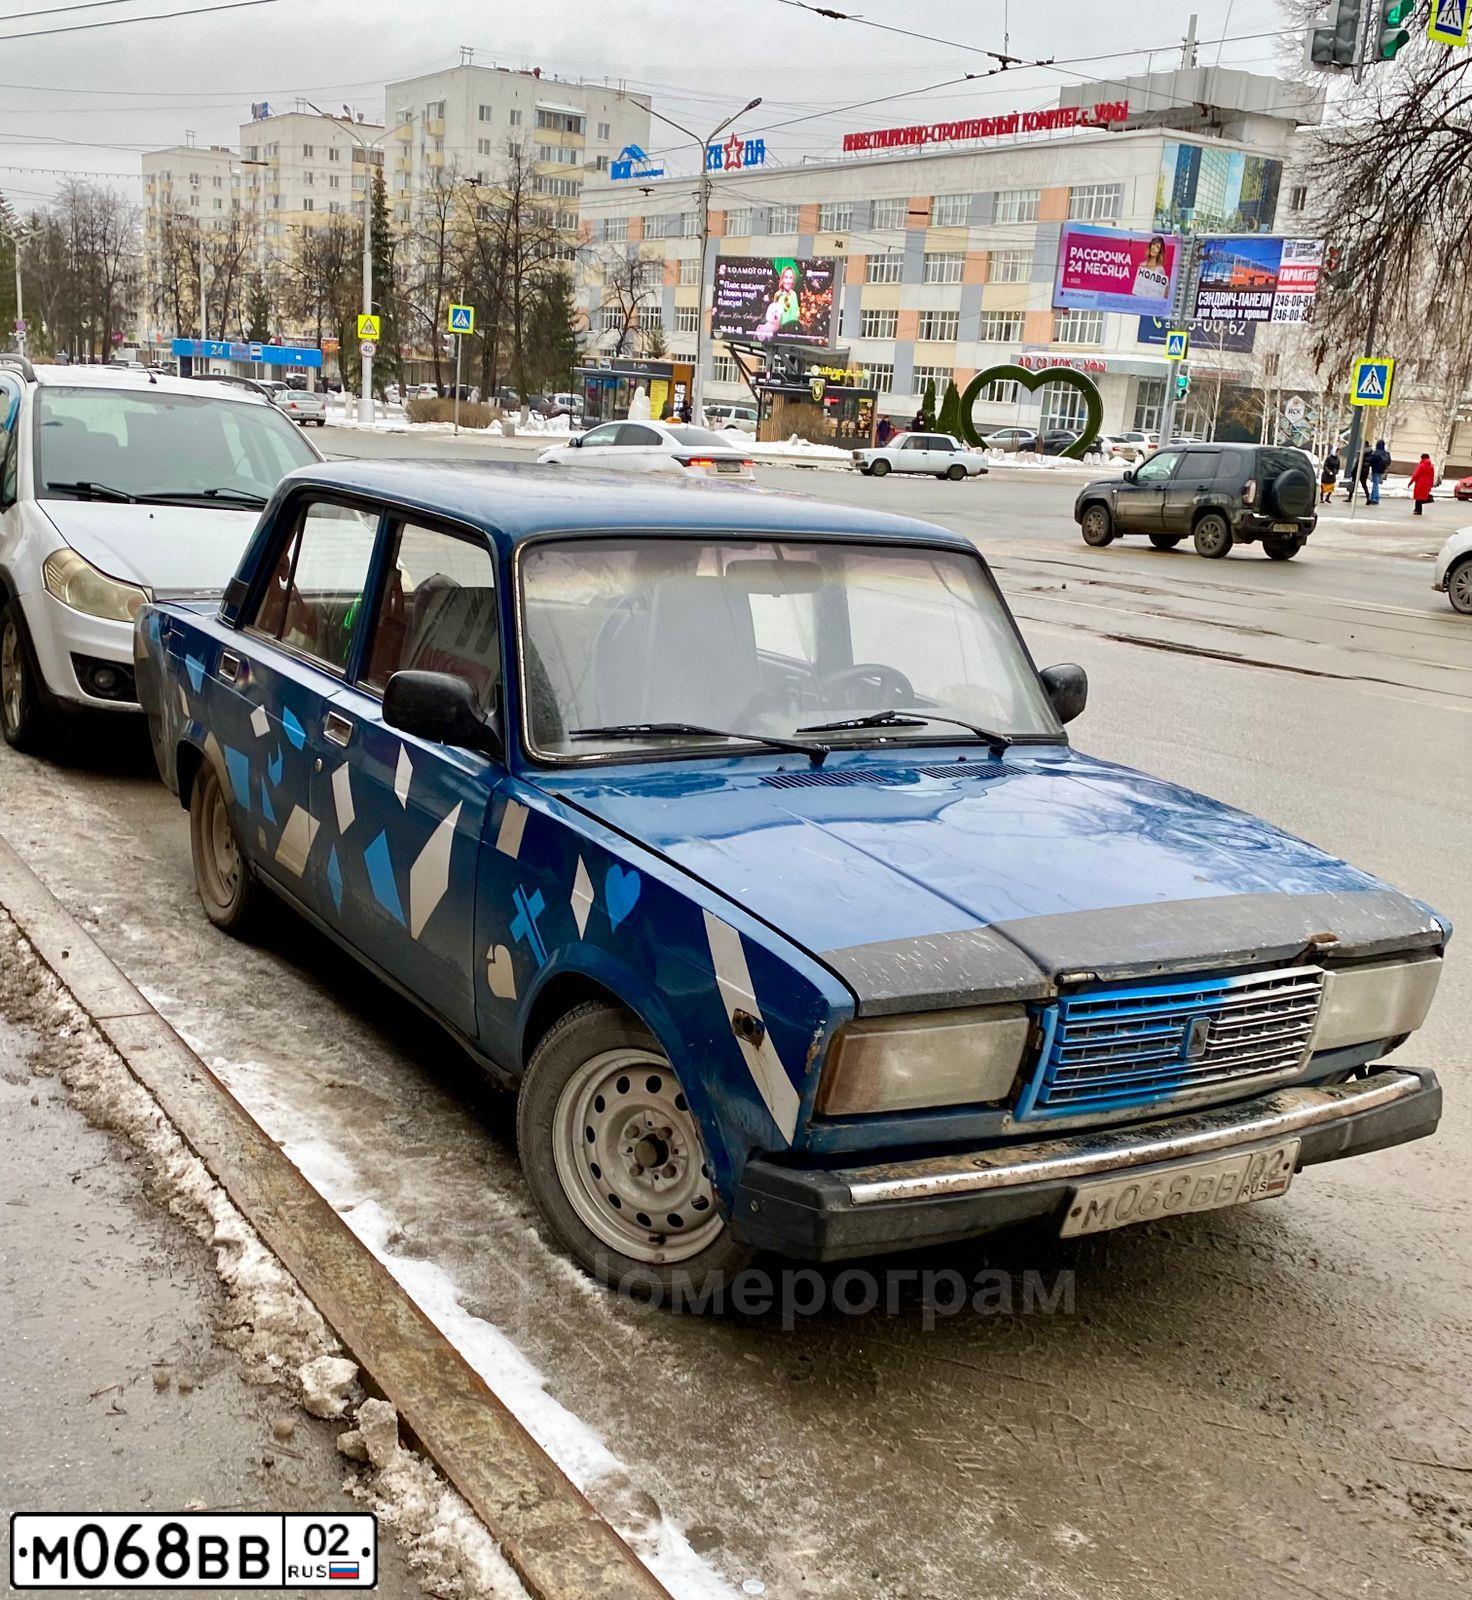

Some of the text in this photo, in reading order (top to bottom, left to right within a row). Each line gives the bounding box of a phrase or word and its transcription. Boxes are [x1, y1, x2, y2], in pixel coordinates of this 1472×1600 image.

[1021, 107, 1080, 132] КОМИТЕТ
[1093, 100, 1129, 122] УФЫ
[1070, 247, 1131, 265] РАССРОЧКА
[1068, 260, 1130, 280] 24 МЕСЯЦА
[1198, 291, 1273, 308] СЭНДВИЧ-ПАНЕЛИ
[1196, 308, 1210, 318] для
[1211, 307, 1237, 319] фасада
[1244, 309, 1269, 320] кровли
[1273, 308, 1311, 321] 246-00-8
[211, 344, 223, 356] 24
[362, 344, 373, 353] 40
[1241, 1180, 1267, 1196] RUS
